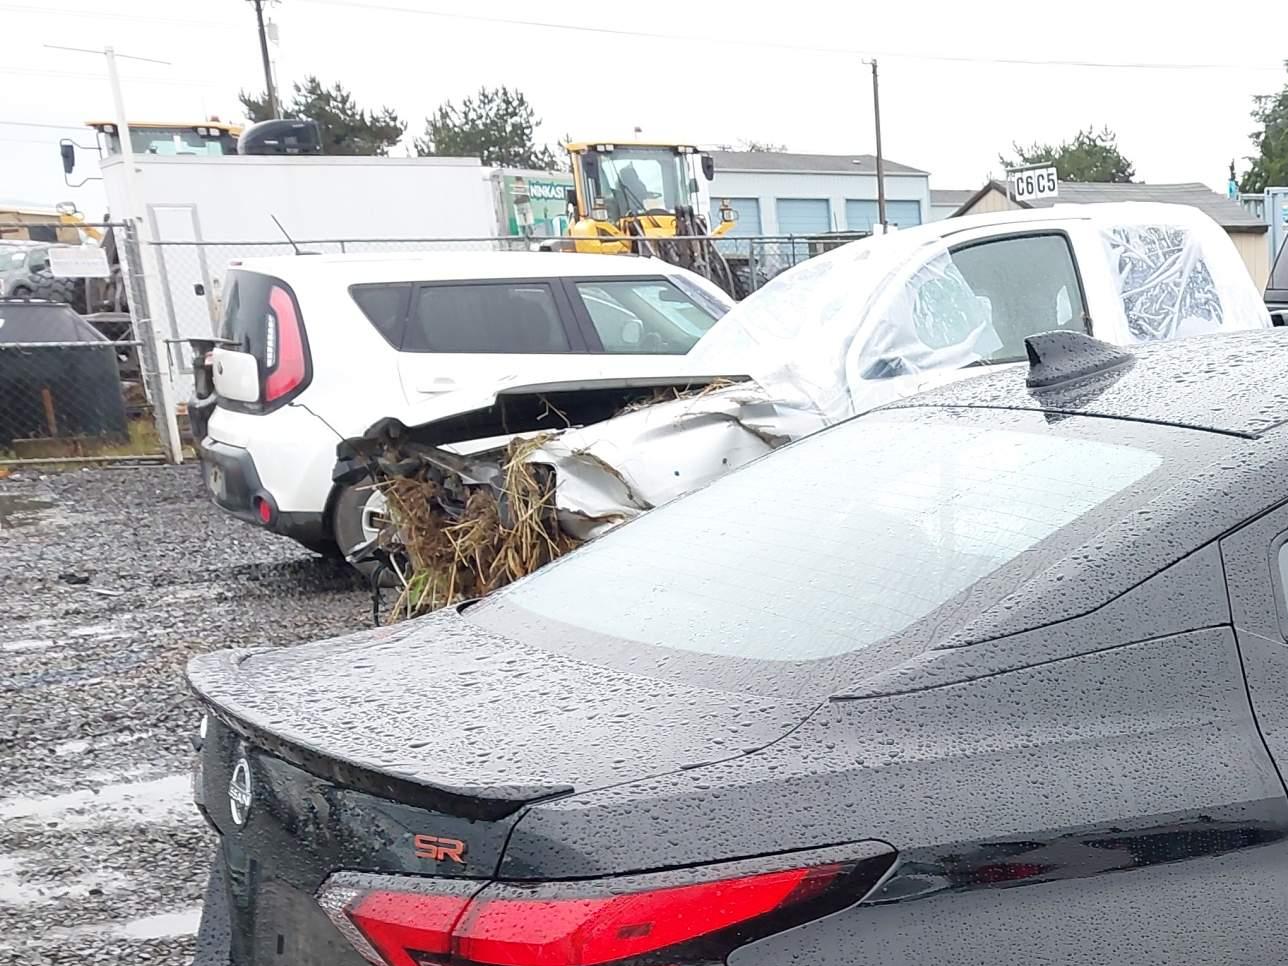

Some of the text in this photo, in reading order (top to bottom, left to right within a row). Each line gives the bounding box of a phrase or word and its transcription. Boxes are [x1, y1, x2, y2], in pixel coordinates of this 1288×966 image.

[1016, 172, 1056, 196] C6 C5
[414, 834, 468, 864] SR
